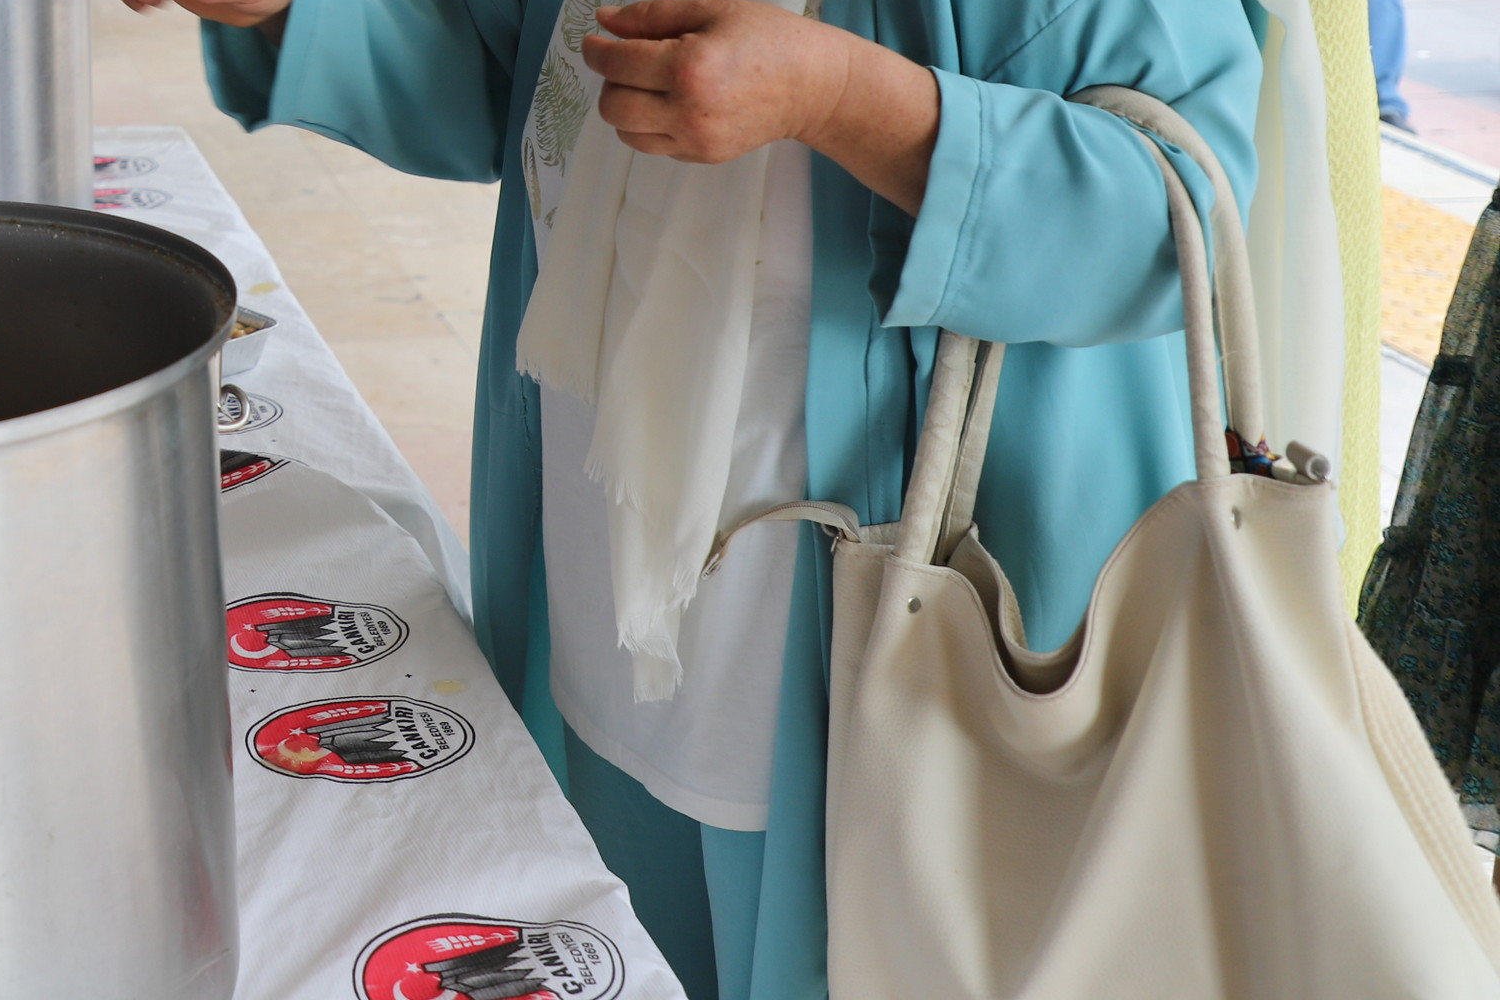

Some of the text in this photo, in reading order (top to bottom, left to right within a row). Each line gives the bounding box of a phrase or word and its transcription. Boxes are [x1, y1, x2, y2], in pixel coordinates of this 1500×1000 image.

[338, 611, 377, 654] ÇANKIRI
[358, 612, 386, 647] BELEDİYESİ
[377, 621, 391, 635] 1869
[395, 707, 440, 759] ÇANKIRI
[417, 712, 450, 750] BELEDİYESİ
[439, 721, 455, 736] 1869
[527, 932, 586, 994] ÇANKIRI
[553, 932, 596, 985] BELEDİYESİ
[582, 942, 602, 965] 1869
